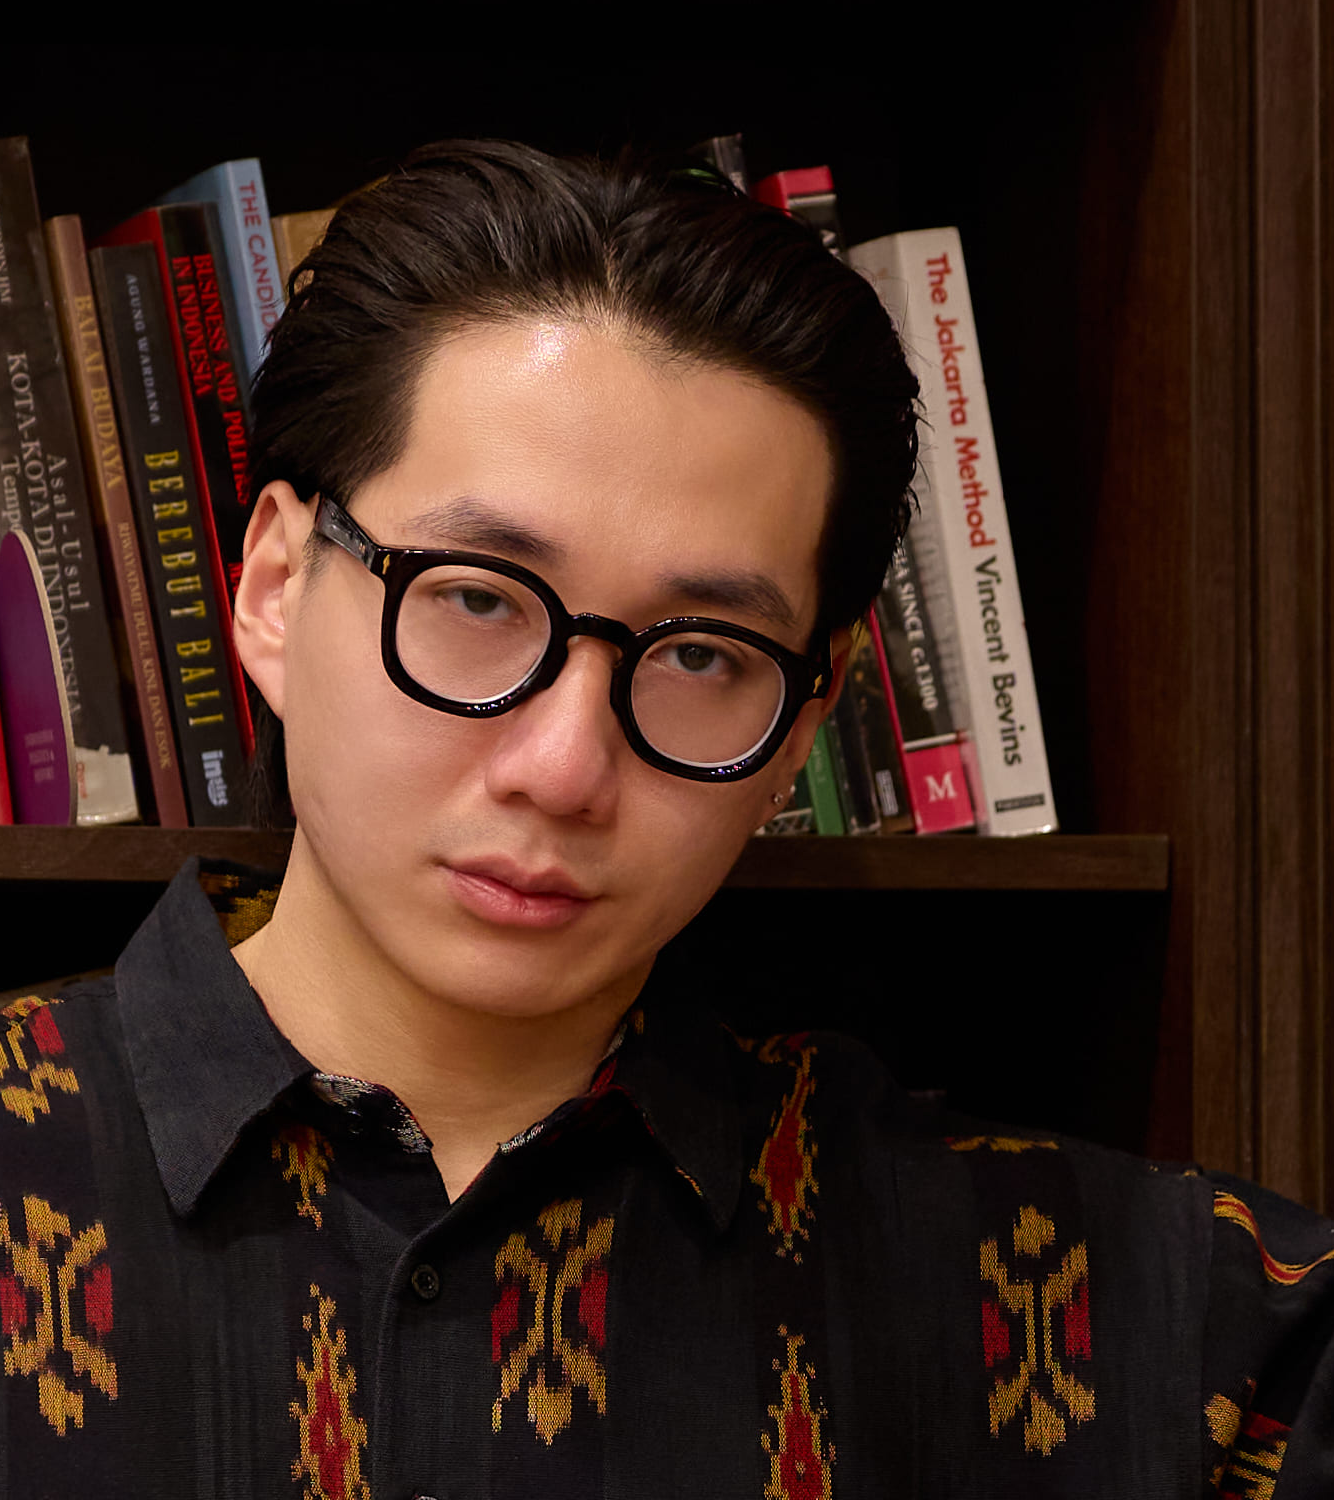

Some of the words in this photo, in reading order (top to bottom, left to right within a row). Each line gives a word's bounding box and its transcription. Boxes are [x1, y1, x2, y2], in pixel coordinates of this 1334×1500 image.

[925, 254, 952, 304] The
[932, 315, 971, 426] Jakarta
[956, 436, 995, 548] Method
[144, 450, 207, 617] BEREBUT
[176, 640, 223, 727] BALI
[974, 557, 1008, 663] Vincent
[993, 673, 1026, 767] Bevins
